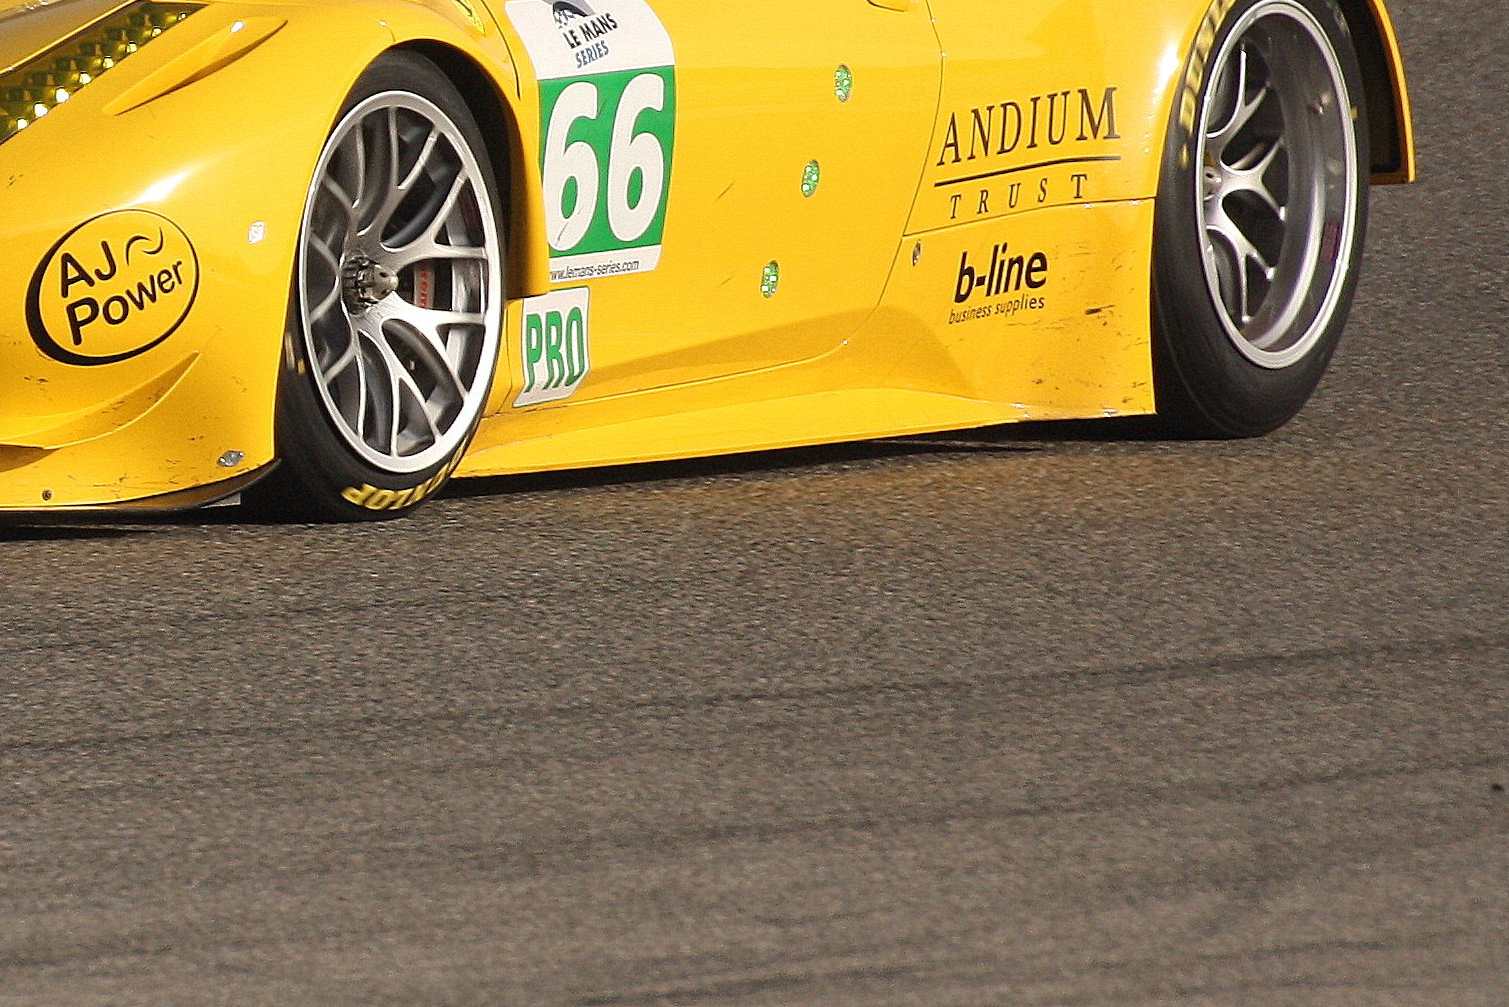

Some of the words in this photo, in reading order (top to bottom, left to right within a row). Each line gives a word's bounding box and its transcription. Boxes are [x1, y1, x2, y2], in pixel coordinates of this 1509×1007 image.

[562, 28, 582, 50] LE
[578, 12, 618, 42] MANS
[575, 39, 609, 69] SERIES
[936, 86, 1121, 167] ANDIUM
[542, 73, 664, 251] 66
[950, 174, 1088, 219] TRUST
[61, 240, 117, 298] AJ
[550, 260, 640, 281] ww.lemans-series.com
[954, 242, 1048, 304] b-line
[66, 260, 183, 346] Power
[949, 306, 993, 325] business
[994, 293, 1045, 317] supplies
[524, 306, 585, 394] PRO
